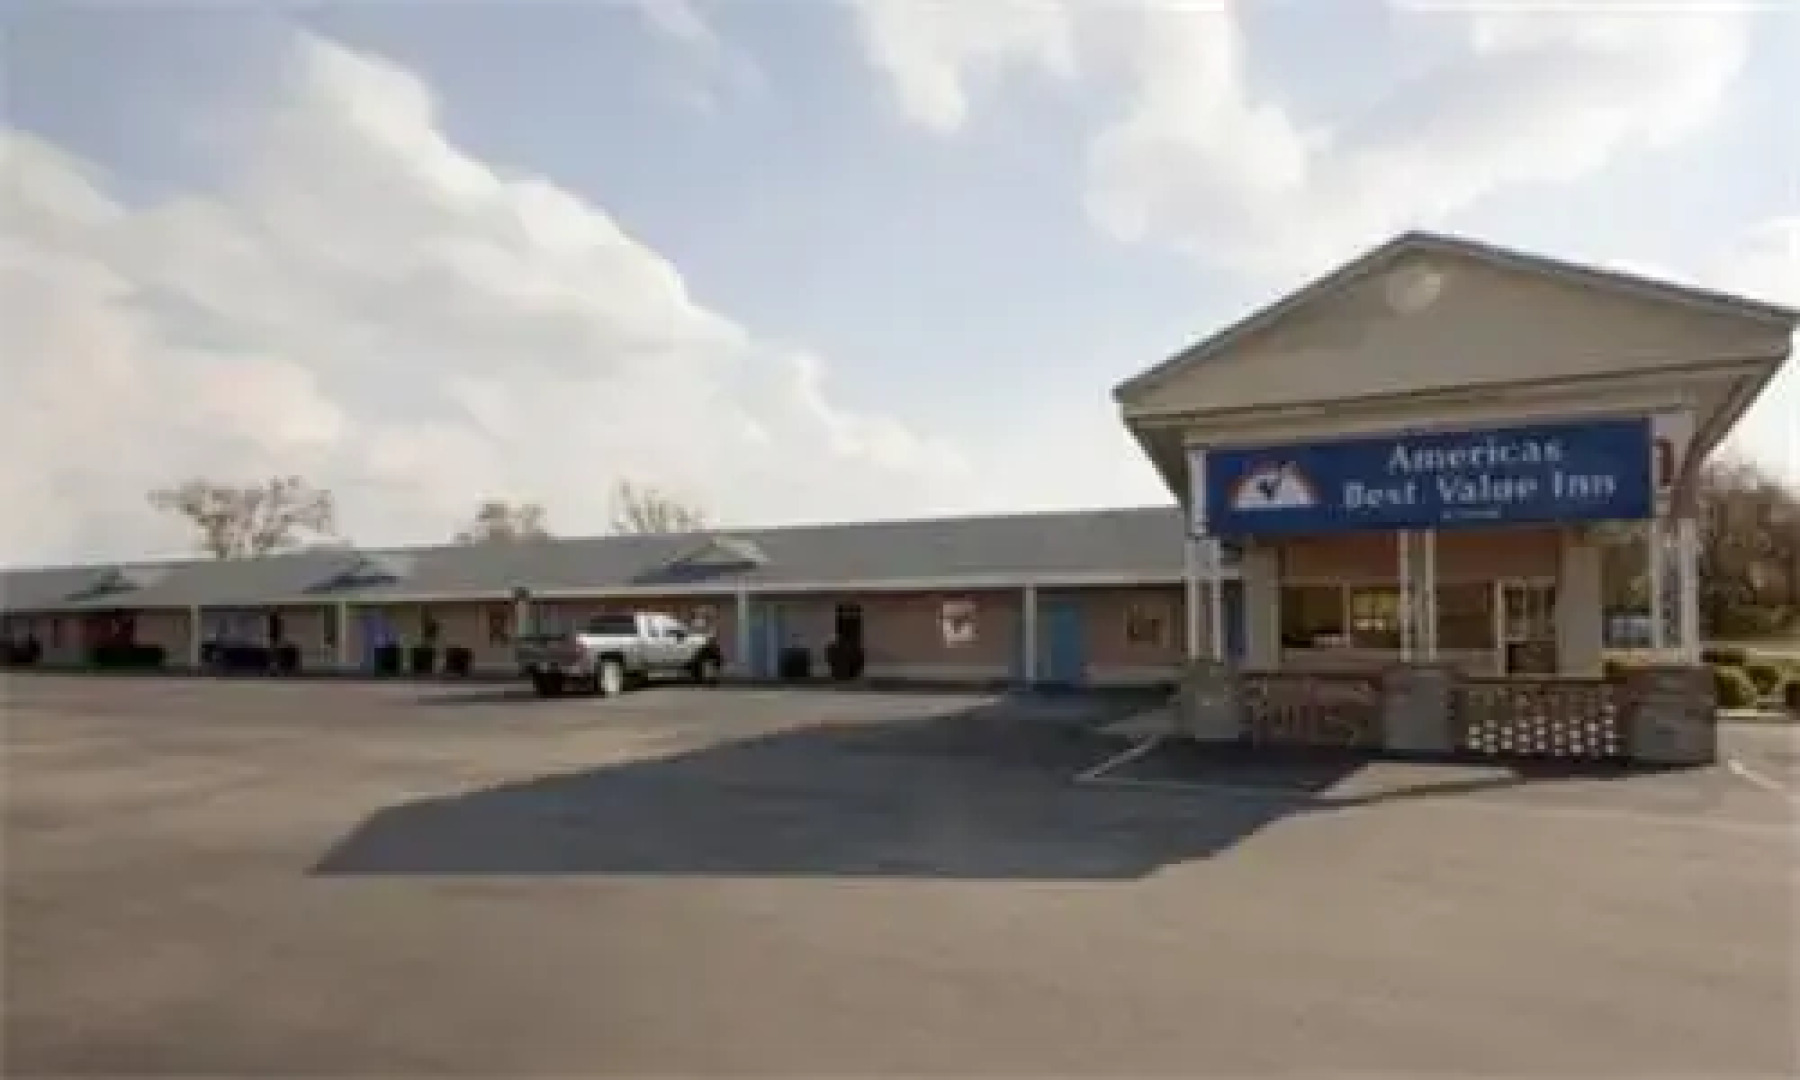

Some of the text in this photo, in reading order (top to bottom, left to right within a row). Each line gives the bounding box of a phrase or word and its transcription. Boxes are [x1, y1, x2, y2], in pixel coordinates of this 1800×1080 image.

[1388, 438, 1564, 475] Americas
[1344, 470, 1618, 510] Best Value Inn
